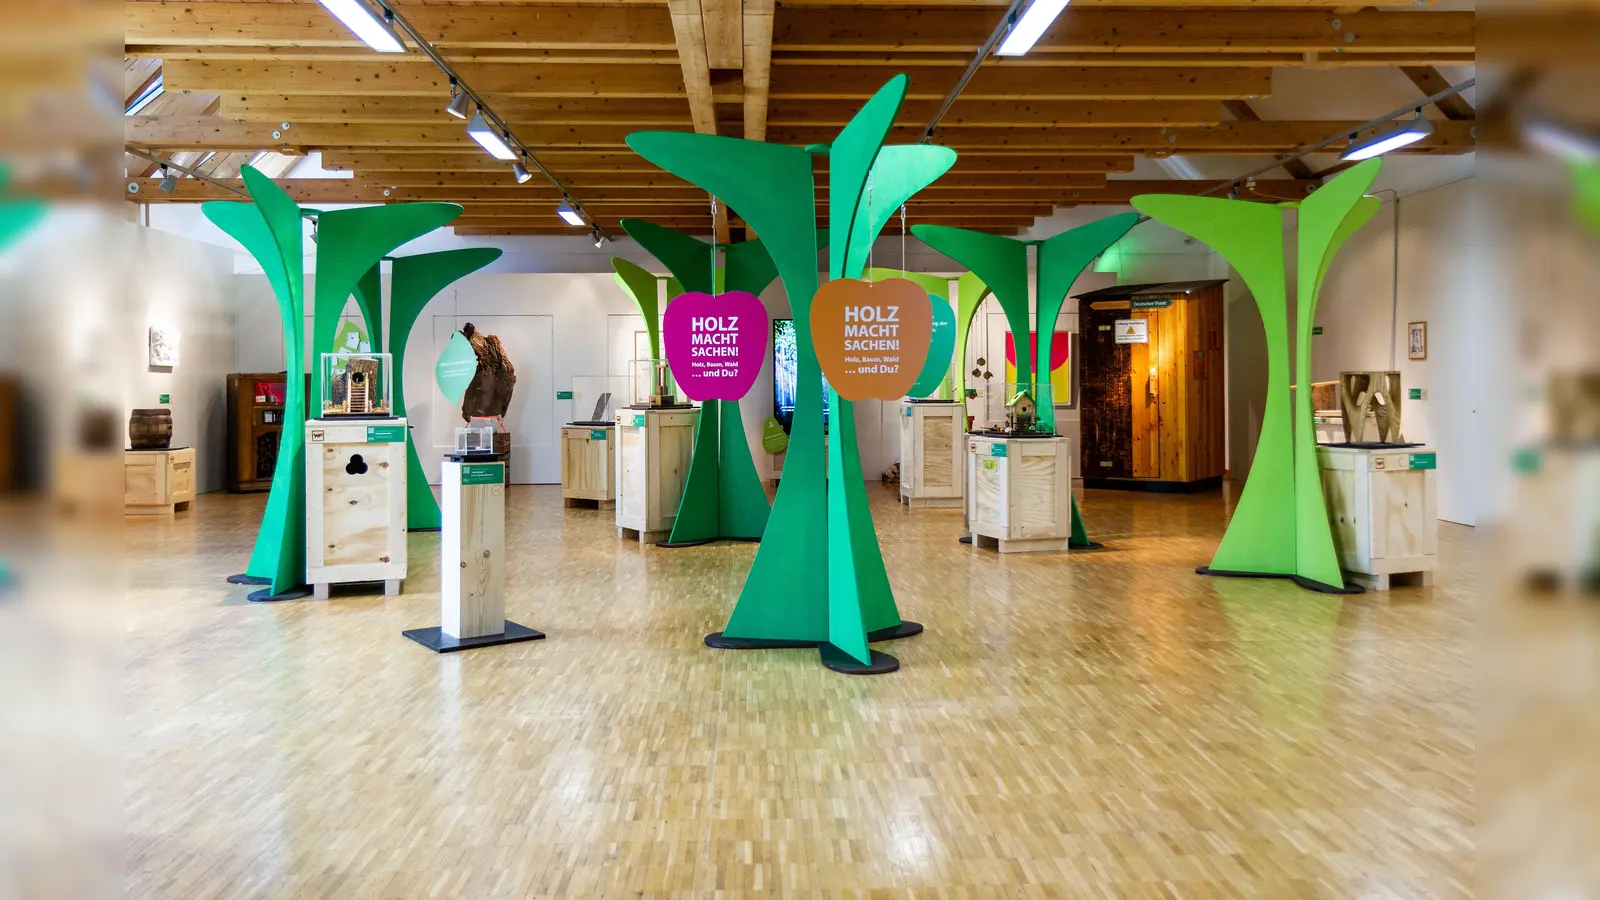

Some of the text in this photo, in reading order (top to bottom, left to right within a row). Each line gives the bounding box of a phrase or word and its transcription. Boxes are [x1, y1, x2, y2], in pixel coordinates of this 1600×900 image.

[844, 305, 900, 322] HOLZ
[691, 316, 739, 332] HOLZ
[844, 324, 900, 338] MACHT
[691, 333, 739, 345] MACHT
[844, 339, 900, 351] SACHEN!
[691, 346, 739, 357] SACHEN!
[703, 369, 720, 377] und
[721, 369, 739, 377] Du?
[858, 365, 878, 374] und
[880, 365, 899, 374] Du?
